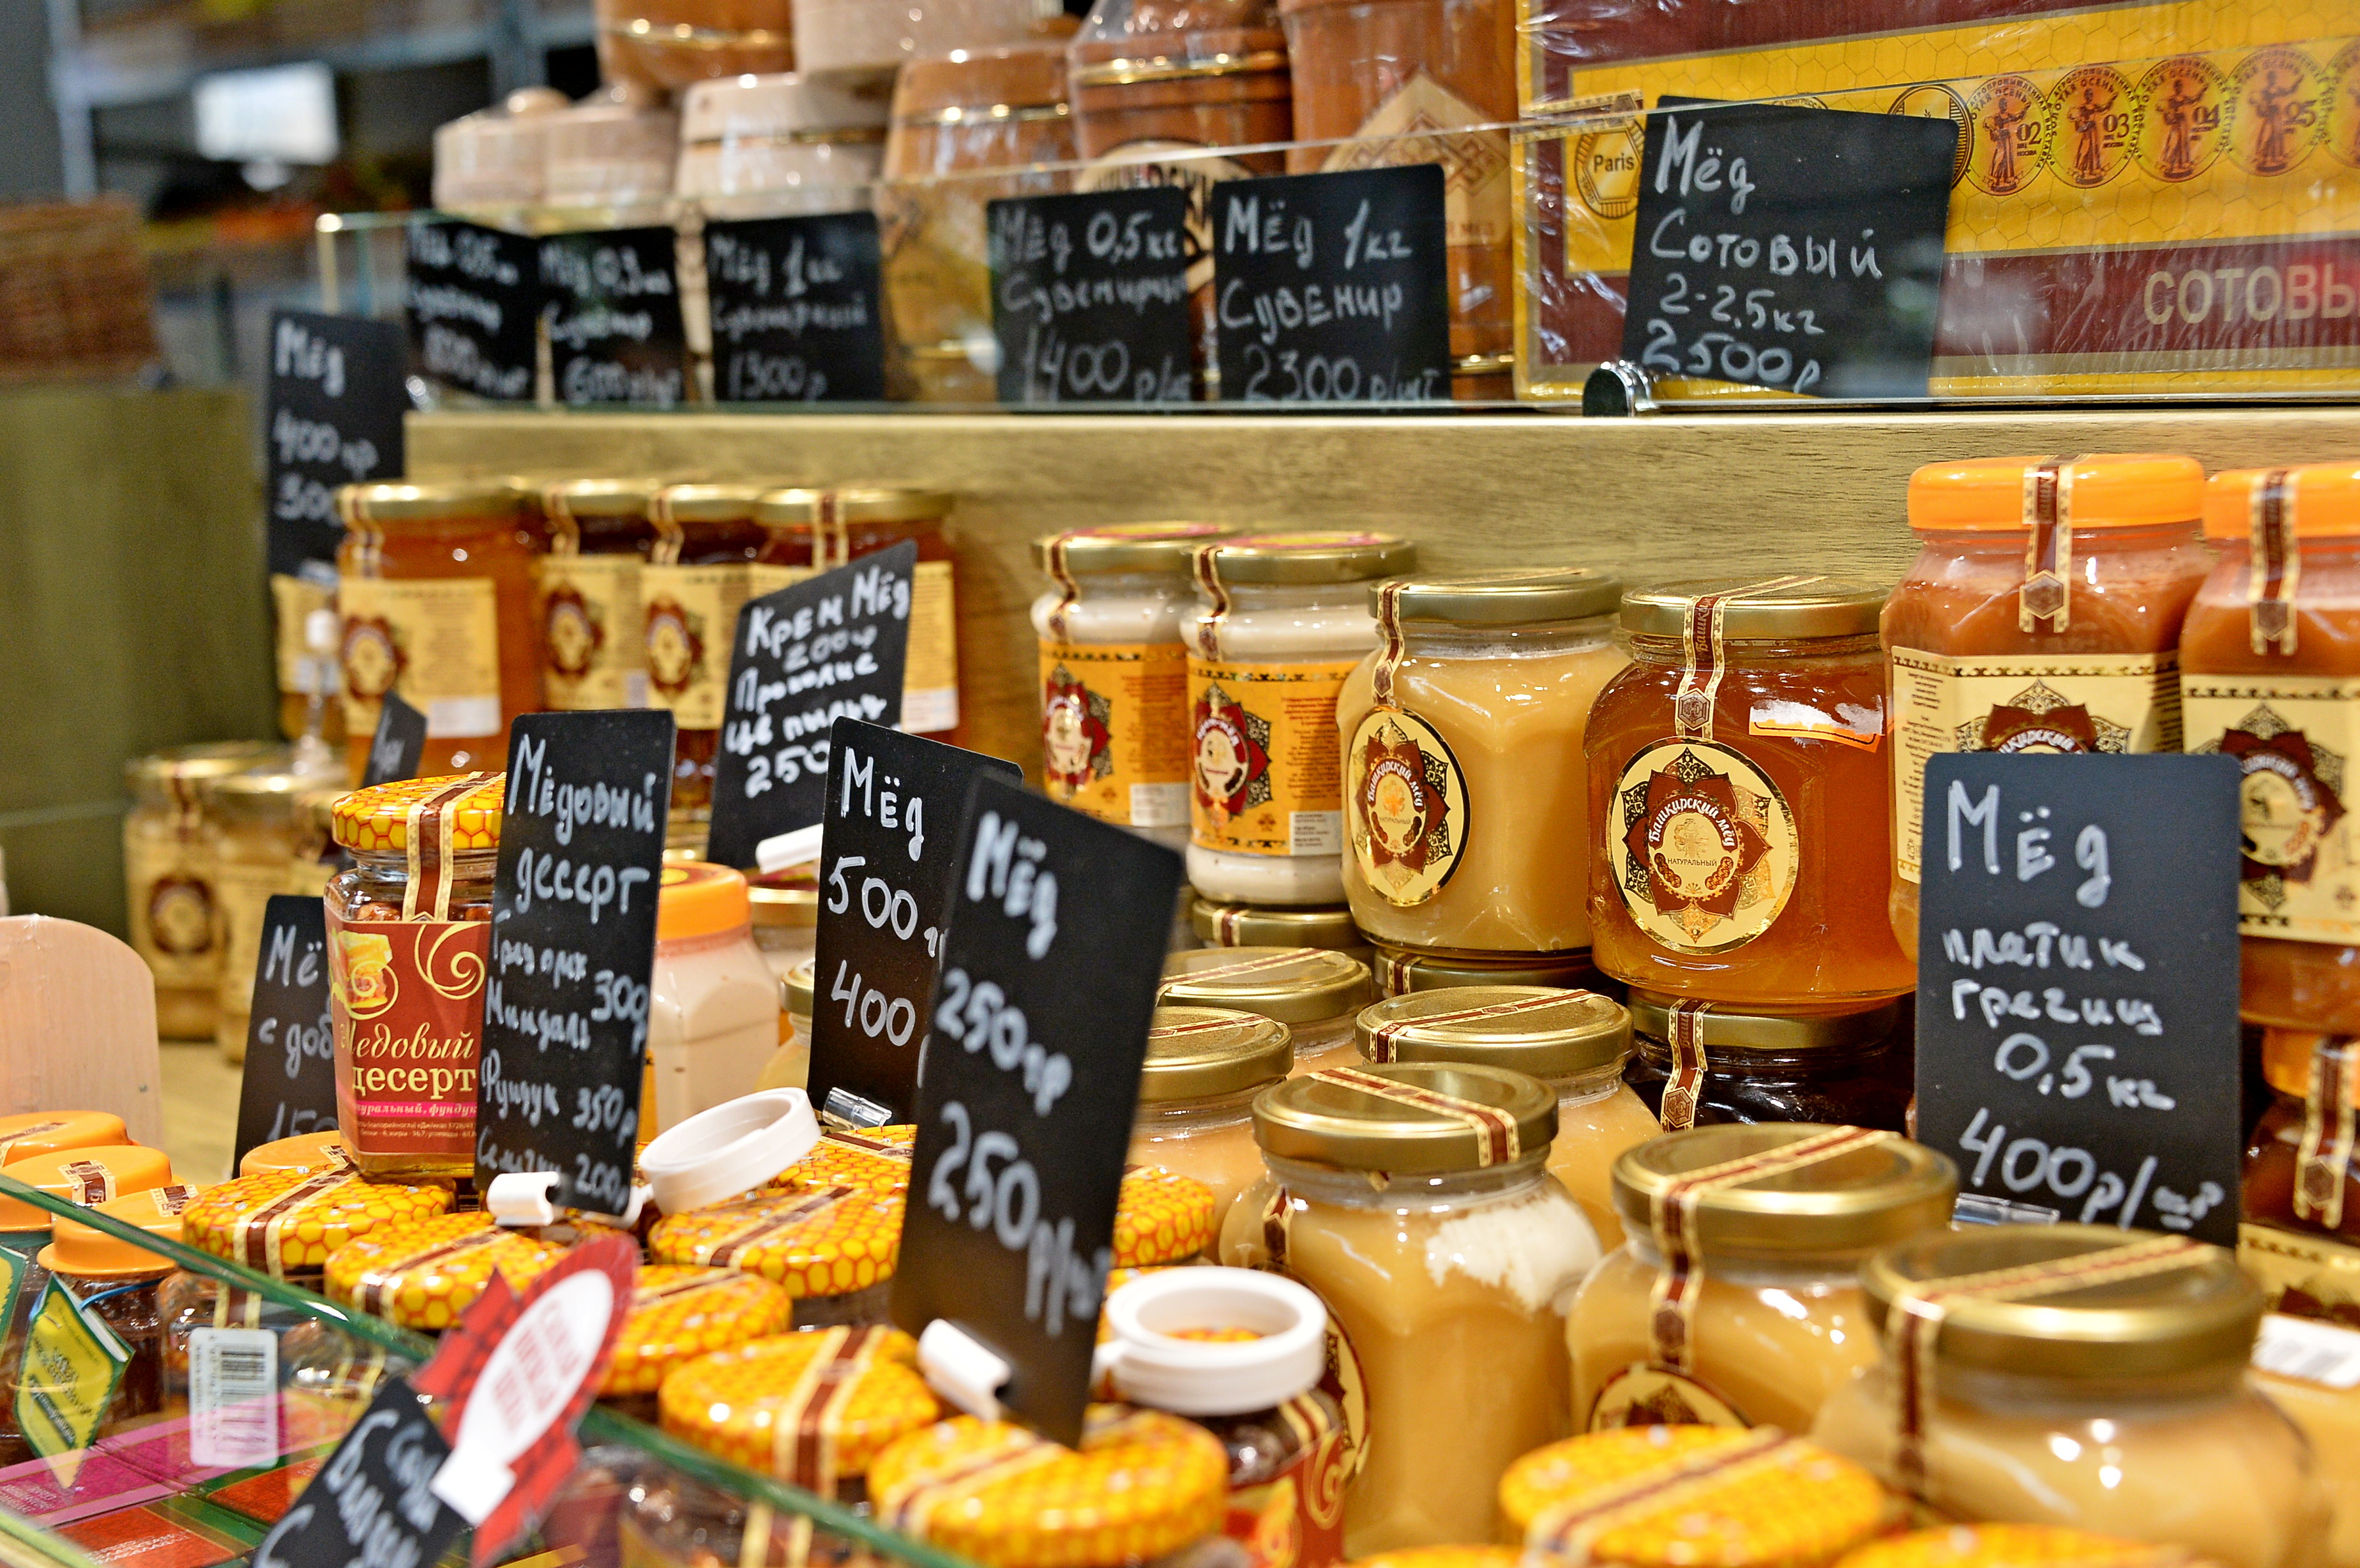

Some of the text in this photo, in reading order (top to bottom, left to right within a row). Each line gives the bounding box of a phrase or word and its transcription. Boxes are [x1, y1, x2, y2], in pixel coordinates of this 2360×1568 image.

[2103, 112, 2131, 139] 03
[2191, 103, 2222, 129] 04
[2016, 120, 2043, 146] 02
[1593, 153, 1635, 172] Paris
[1367, 760, 1412, 802] Башкирский
[1648, 797, 1736, 847] Башкирский мёд
[1667, 857, 1718, 868] НАТУРАЛЬНЫЙ
